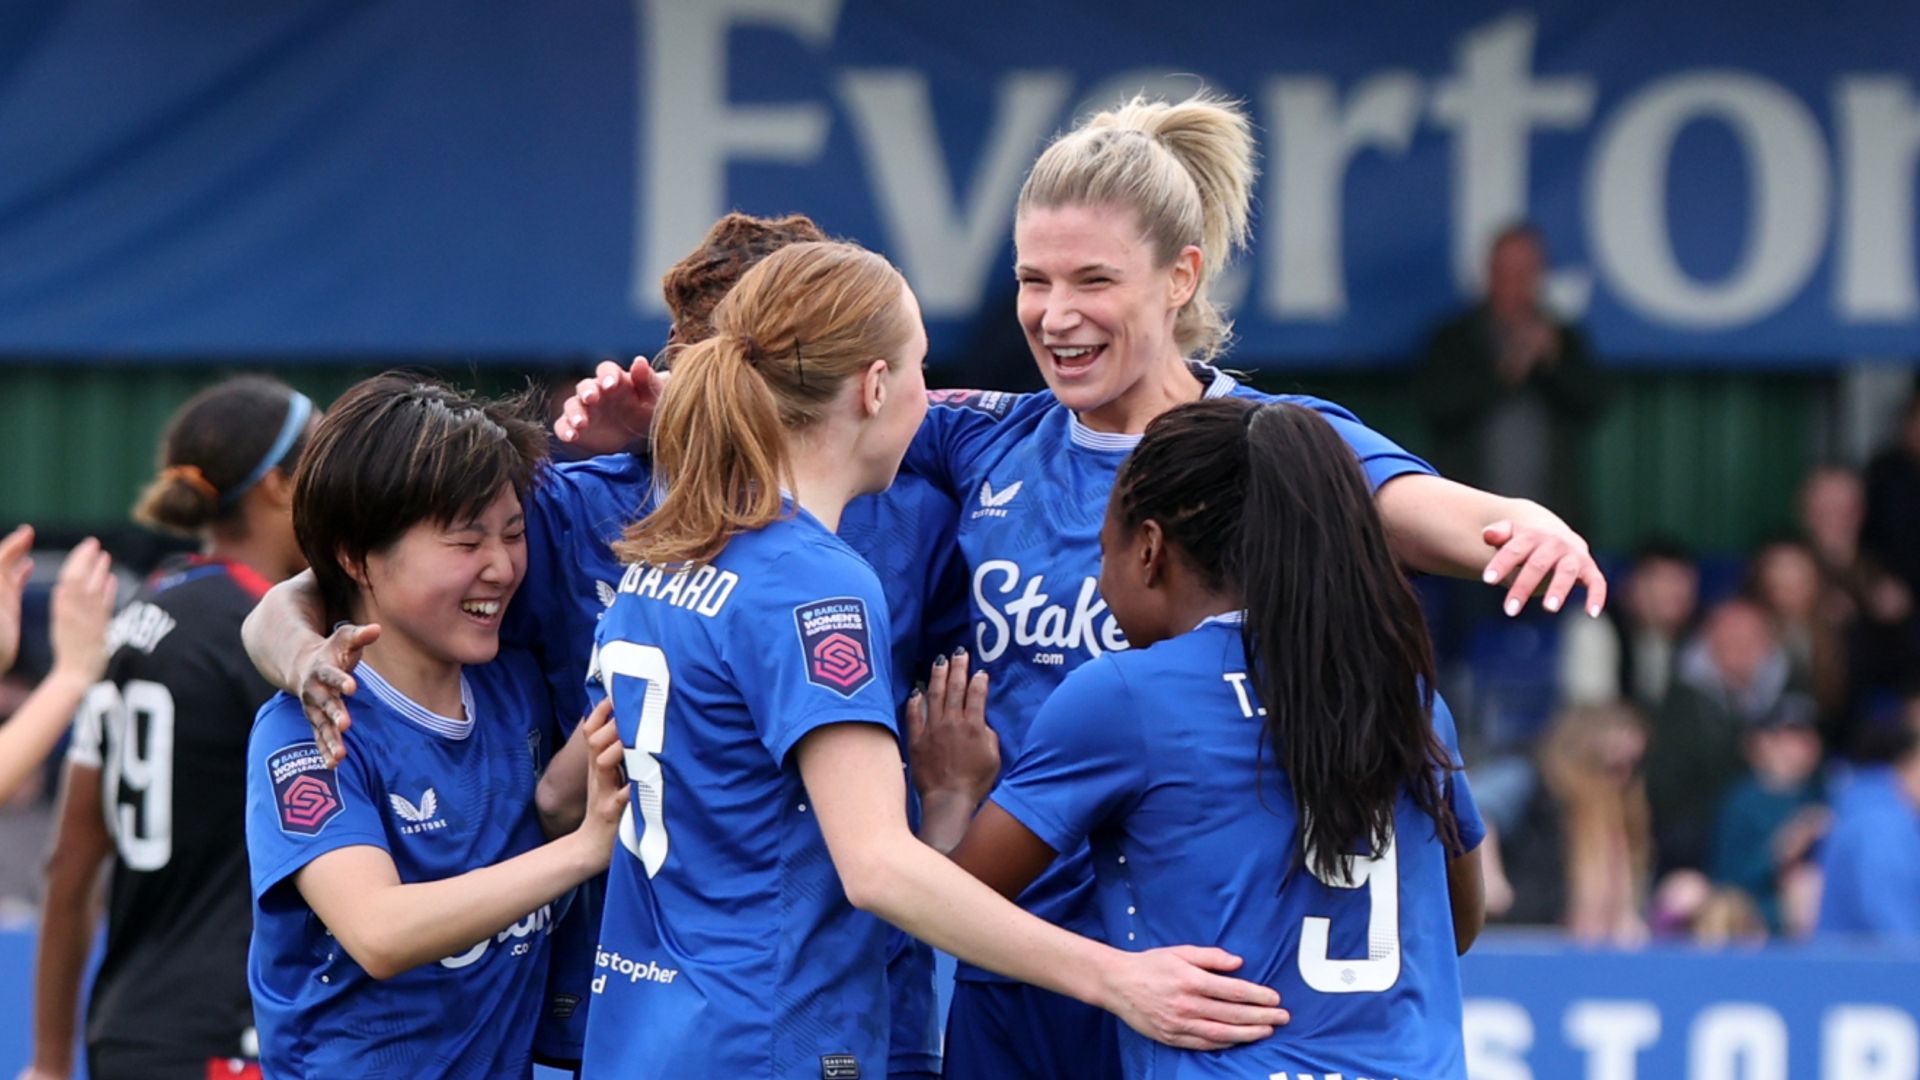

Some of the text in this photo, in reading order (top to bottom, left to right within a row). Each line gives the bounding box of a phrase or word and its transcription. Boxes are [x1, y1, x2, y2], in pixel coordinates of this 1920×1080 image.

[640, 0, 1920, 330] Evrto
[617, 561, 739, 617] GAARD
[814, 604, 860, 616] BARCLAYS
[973, 560, 1131, 663] Stake
[804, 613, 862, 630] WOMEN'S
[1032, 653, 1064, 665] .com
[1223, 672, 1267, 718] T.
[281, 748, 321, 763] BARCLAY
[1298, 798, 1400, 993] 9
